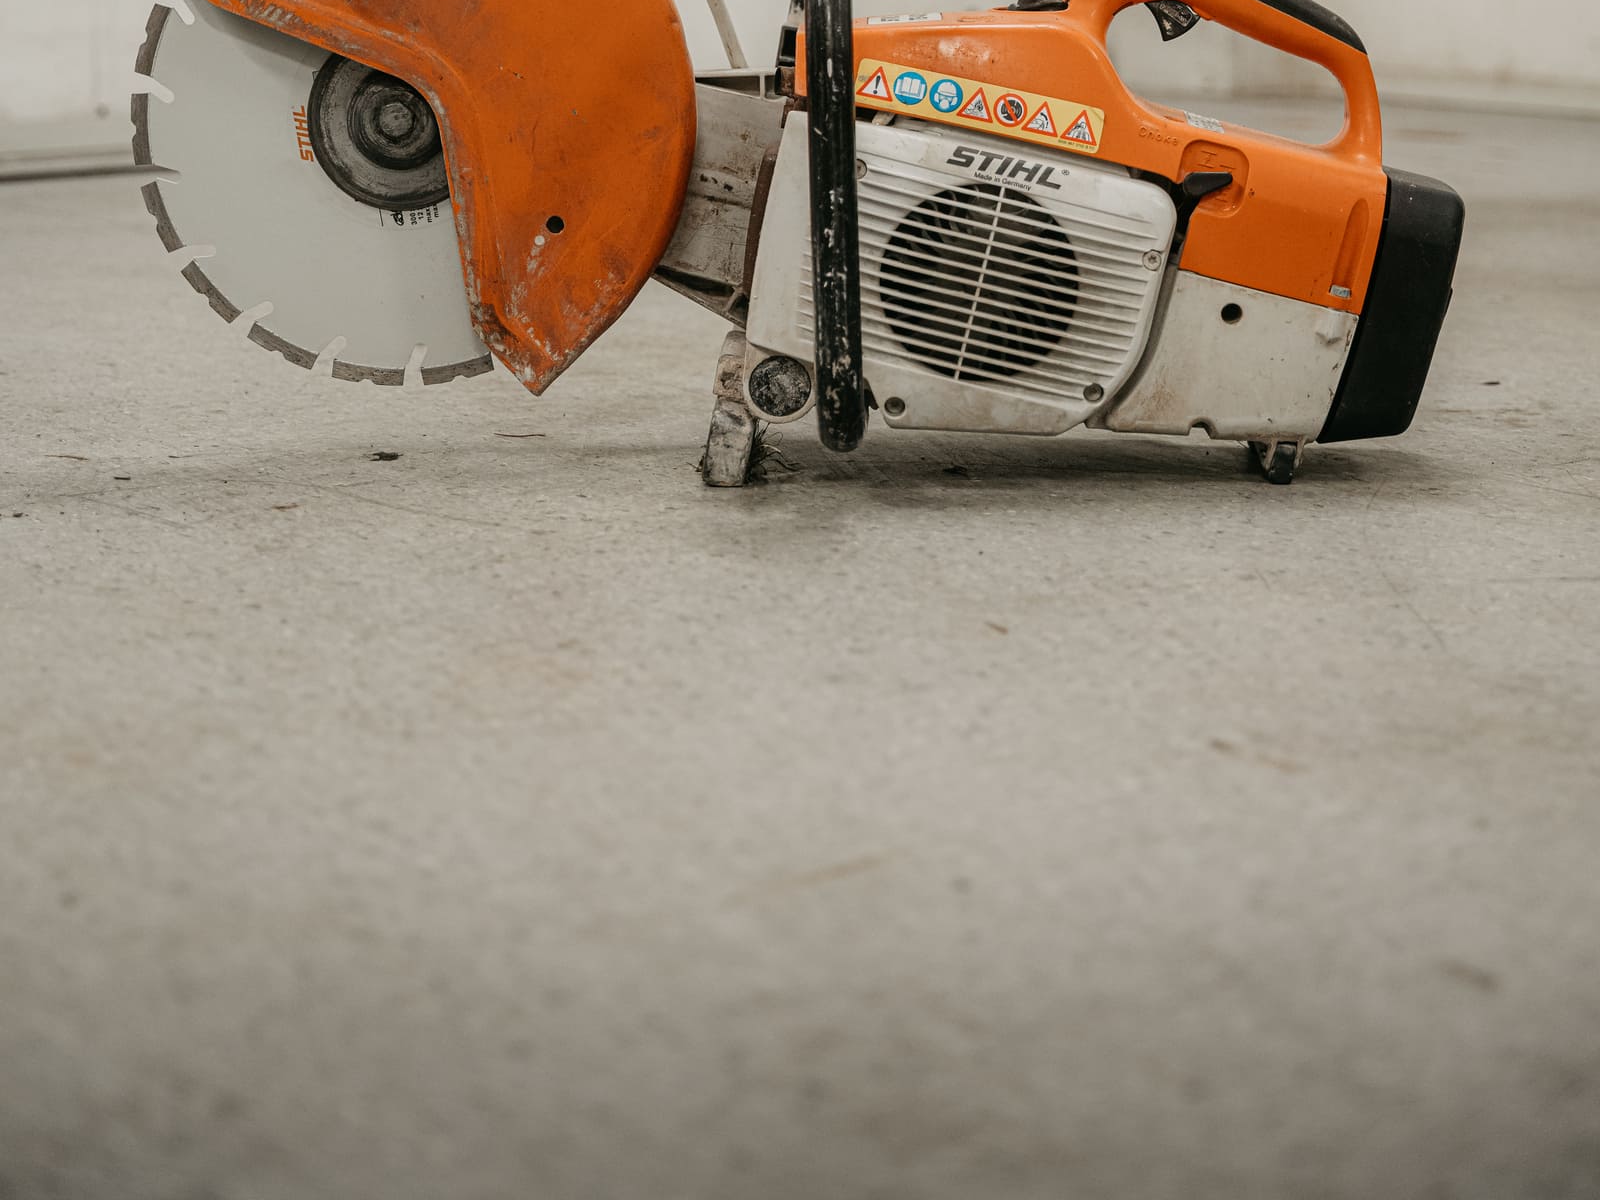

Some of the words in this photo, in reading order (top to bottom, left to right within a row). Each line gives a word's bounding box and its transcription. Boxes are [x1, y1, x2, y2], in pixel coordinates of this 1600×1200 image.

[293, 105, 314, 162] STIHL
[946, 146, 1062, 190] STIHL
[974, 172, 993, 181] Made
[1002, 178, 1031, 191] Germany
